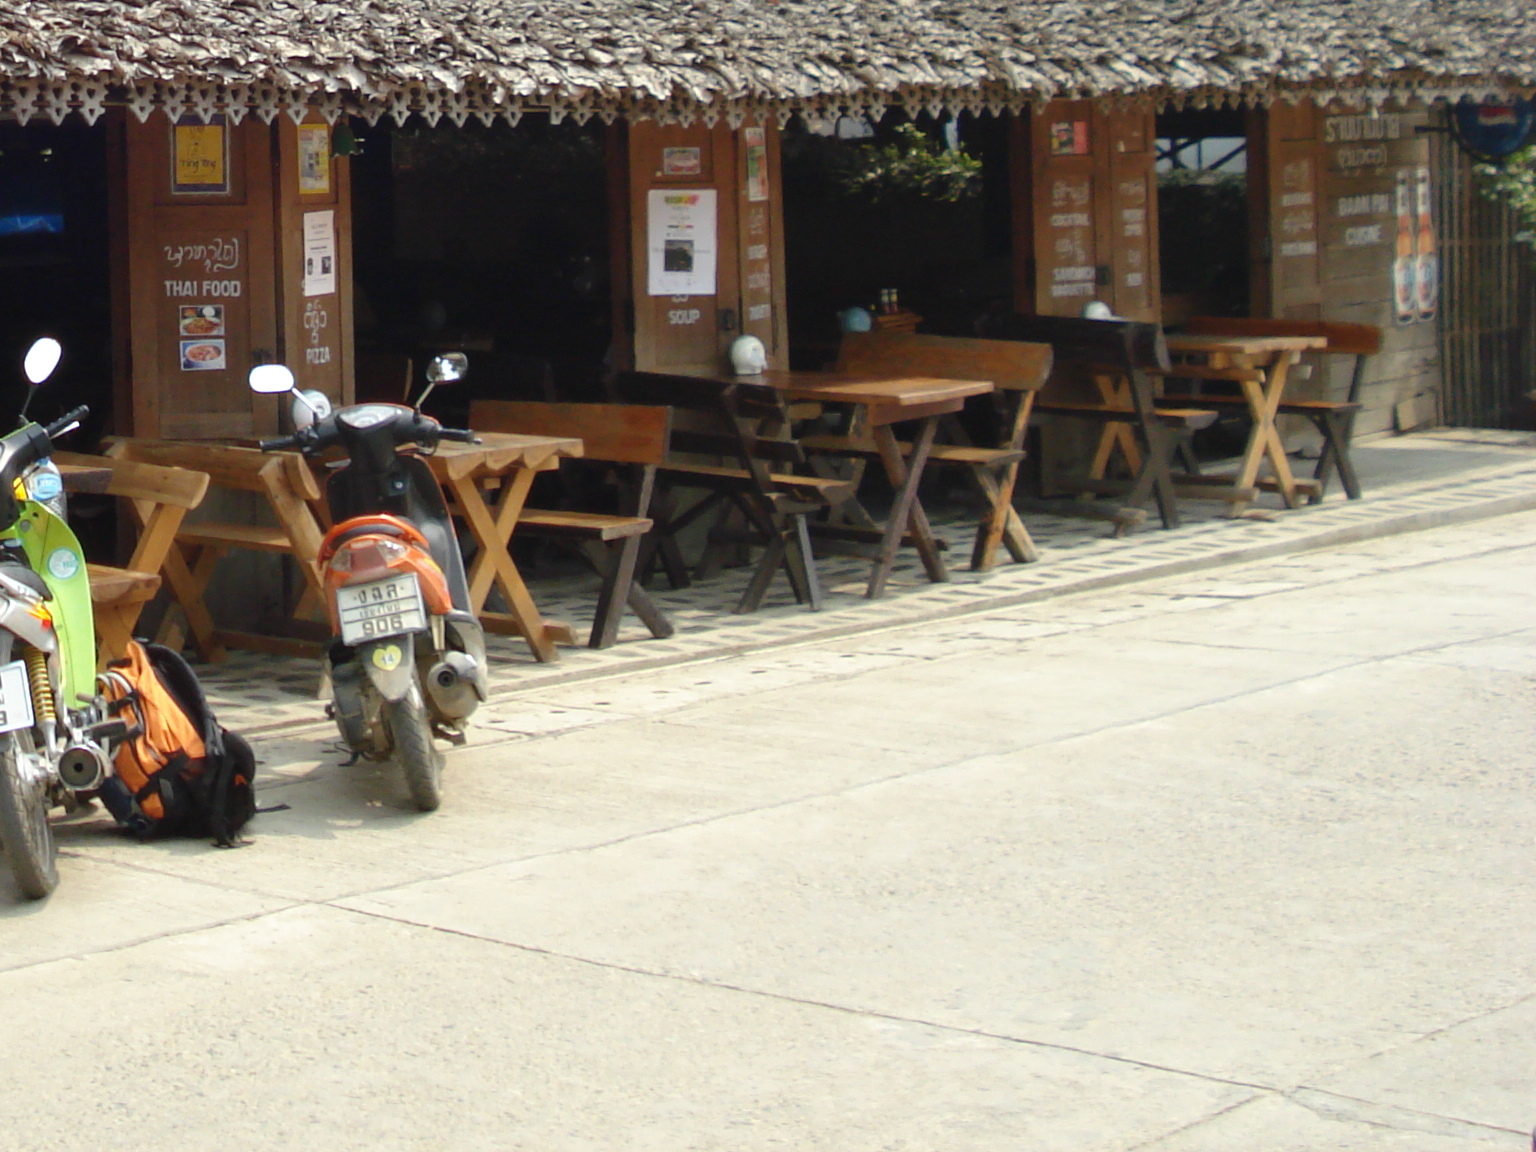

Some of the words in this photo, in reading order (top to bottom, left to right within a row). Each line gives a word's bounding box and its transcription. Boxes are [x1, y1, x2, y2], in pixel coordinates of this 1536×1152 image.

[164, 280, 197, 297] THAI
[202, 280, 241, 298] FOOD
[667, 309, 701, 325] SOUP
[306, 346, 331, 364] PIZZA
[362, 615, 403, 637] 906
